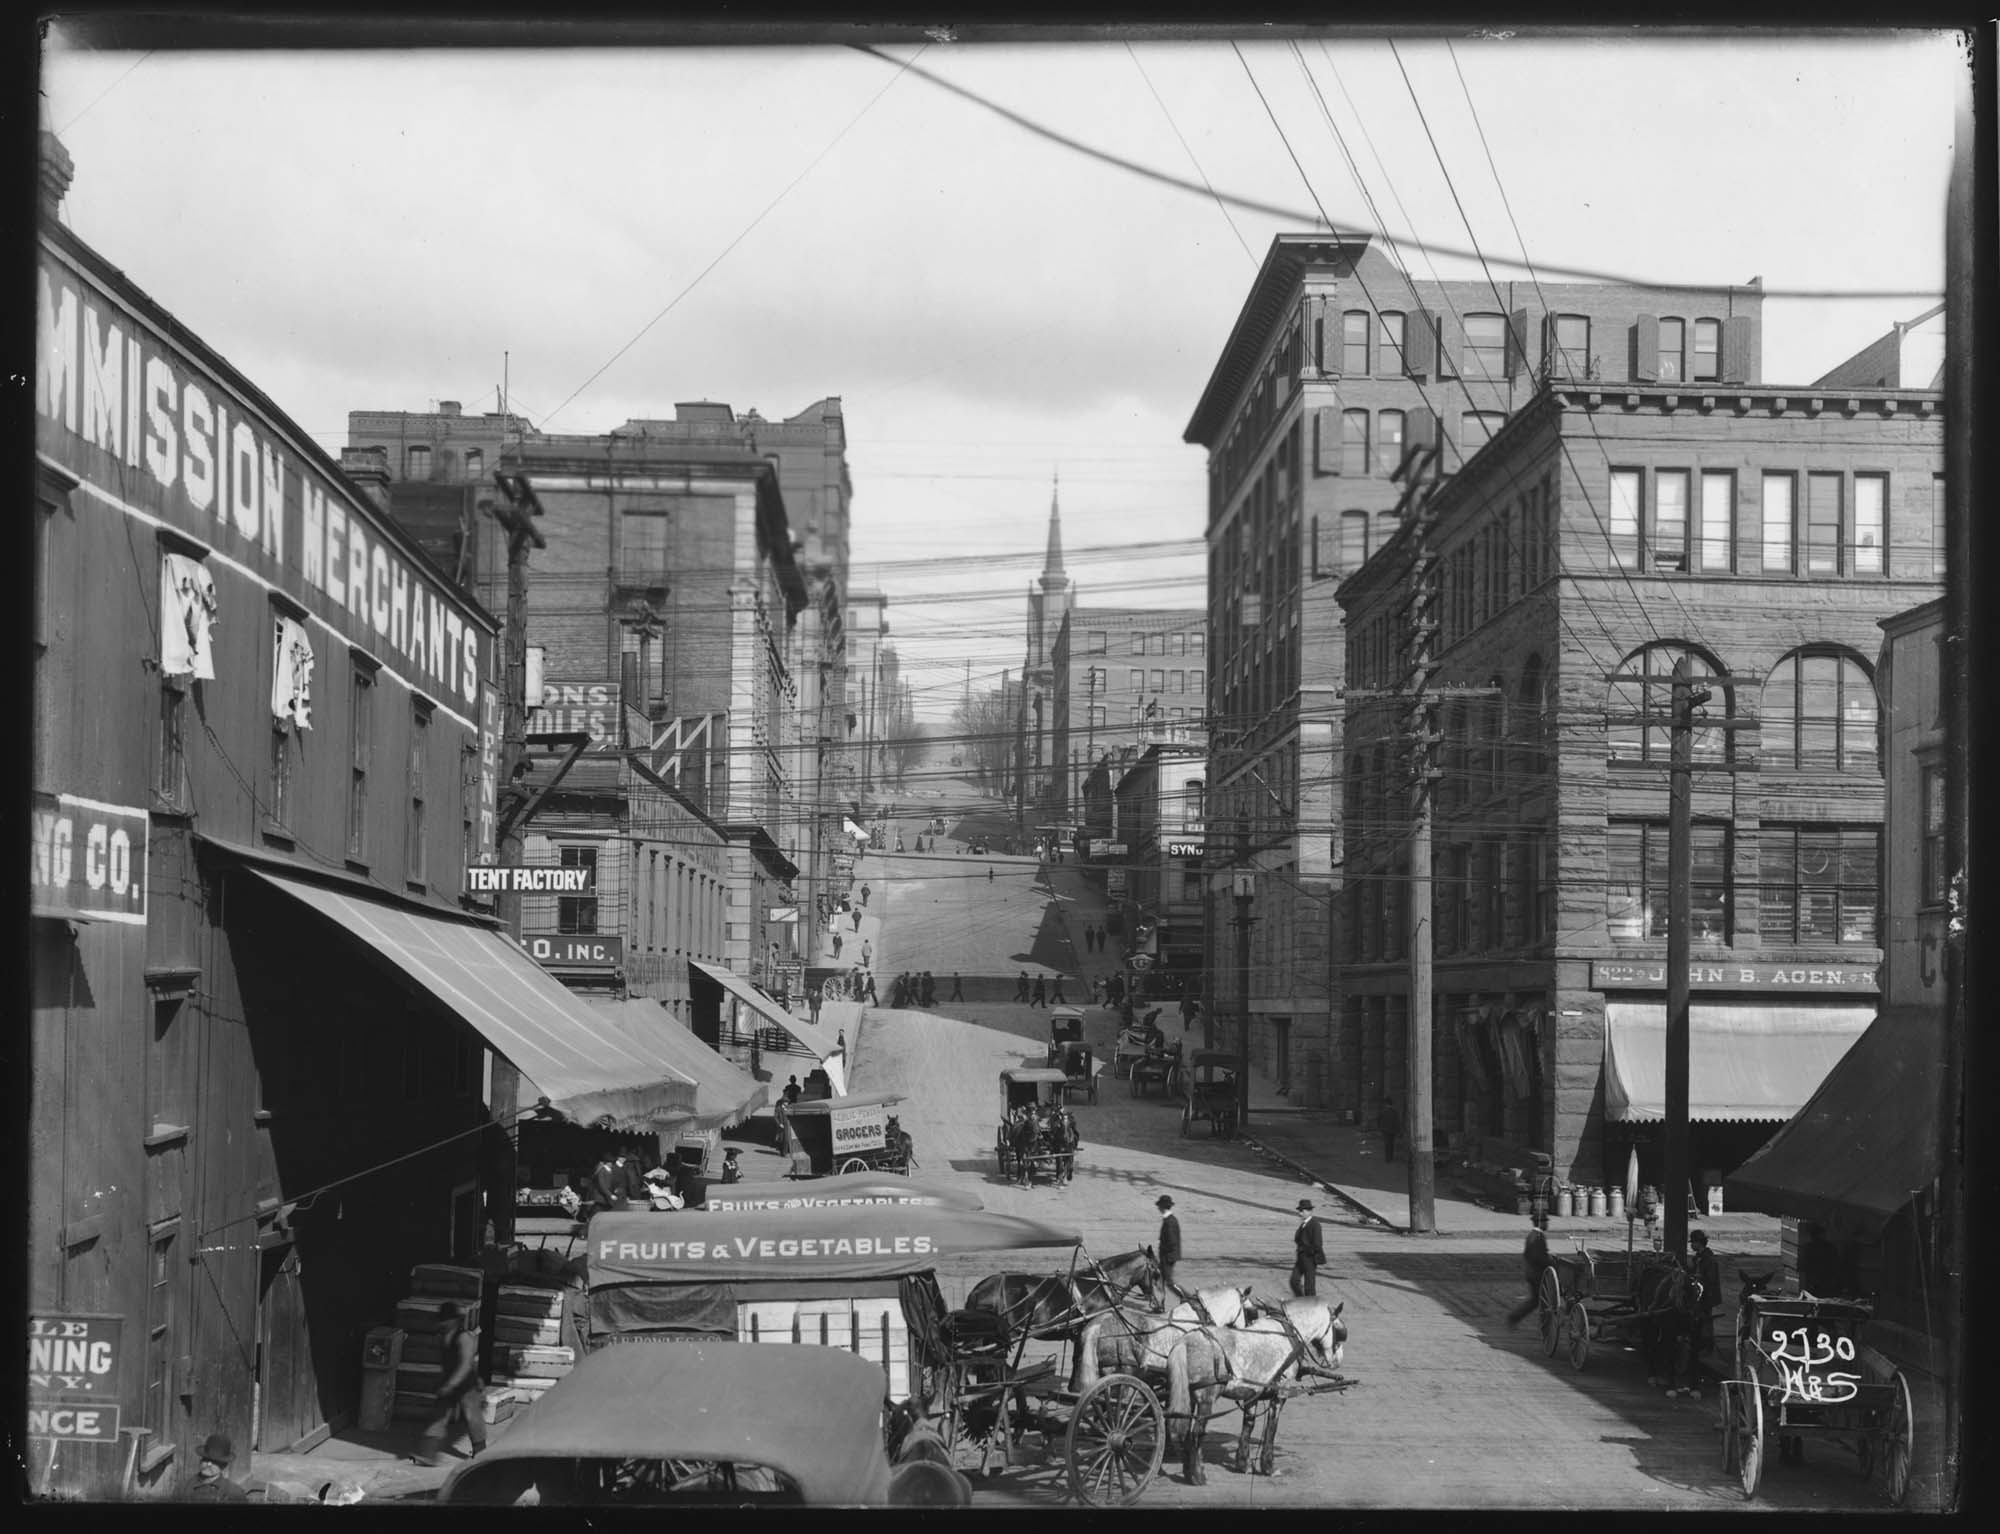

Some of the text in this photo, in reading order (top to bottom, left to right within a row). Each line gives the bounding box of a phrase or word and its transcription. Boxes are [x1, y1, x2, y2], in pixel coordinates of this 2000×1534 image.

[37, 265, 478, 704] MMISSION MERCHANTS
[86, 823, 139, 900] CO.
[468, 868, 588, 891] TENT FACTORY
[567, 944, 615, 962] INC.
[1599, 966, 1633, 981] 822
[1648, 967, 1724, 984] JHN
[1739, 968, 1761, 984] B.
[1771, 969, 1846, 986] AGEN.
[835, 1124, 882, 1141] GROCERS
[600, 1236, 939, 1260] FRUITS & VEGETABLES.
[29, 1338, 113, 1374] NING
[27, 1409, 101, 1436] NCE
